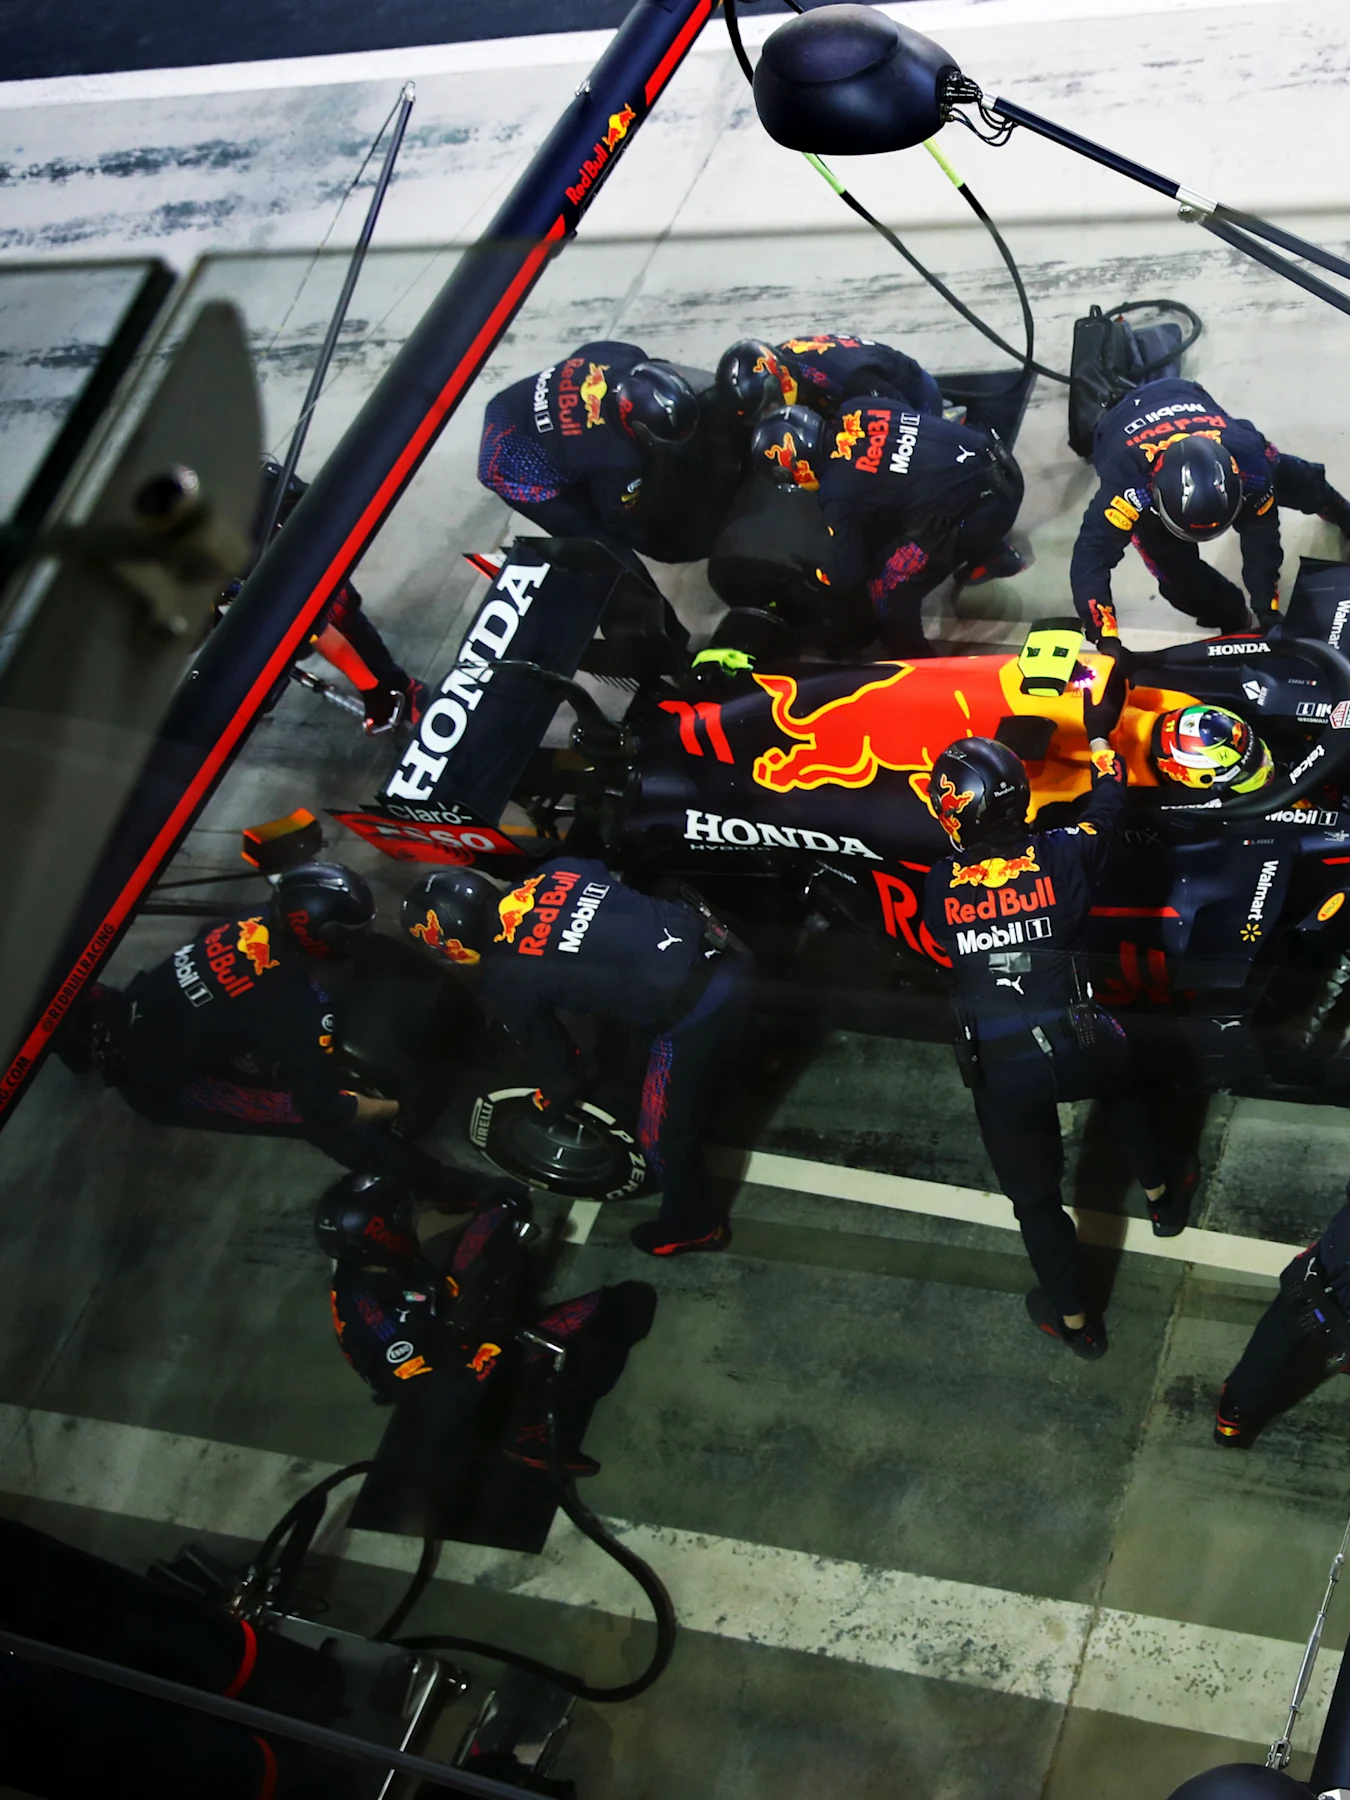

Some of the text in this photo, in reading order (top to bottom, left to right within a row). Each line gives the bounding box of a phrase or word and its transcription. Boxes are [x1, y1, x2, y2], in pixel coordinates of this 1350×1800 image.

[558, 394, 583, 437] Bull
[889, 426, 919, 475] Mobil
[1208, 642, 1271, 656] HONDA
[386, 562, 551, 801] HONDA
[658, 700, 735, 764] 11
[1288, 745, 1325, 784] telcel
[684, 809, 884, 861] HONDA
[518, 871, 582, 957] Red Bull
[944, 876, 1057, 926] Red Bull
[1247, 860, 1280, 921] Walmart
[558, 881, 611, 953] Mobil 1
[956, 916, 1053, 955] Mobil 1
[41, 923, 115, 1033] @REDBULLRACING
[184, 981, 214, 1008] 1
[209, 953, 255, 998] Bull
[470, 1097, 494, 1148] PIRELLI
[605, 1129, 647, 1200] P ZERO
